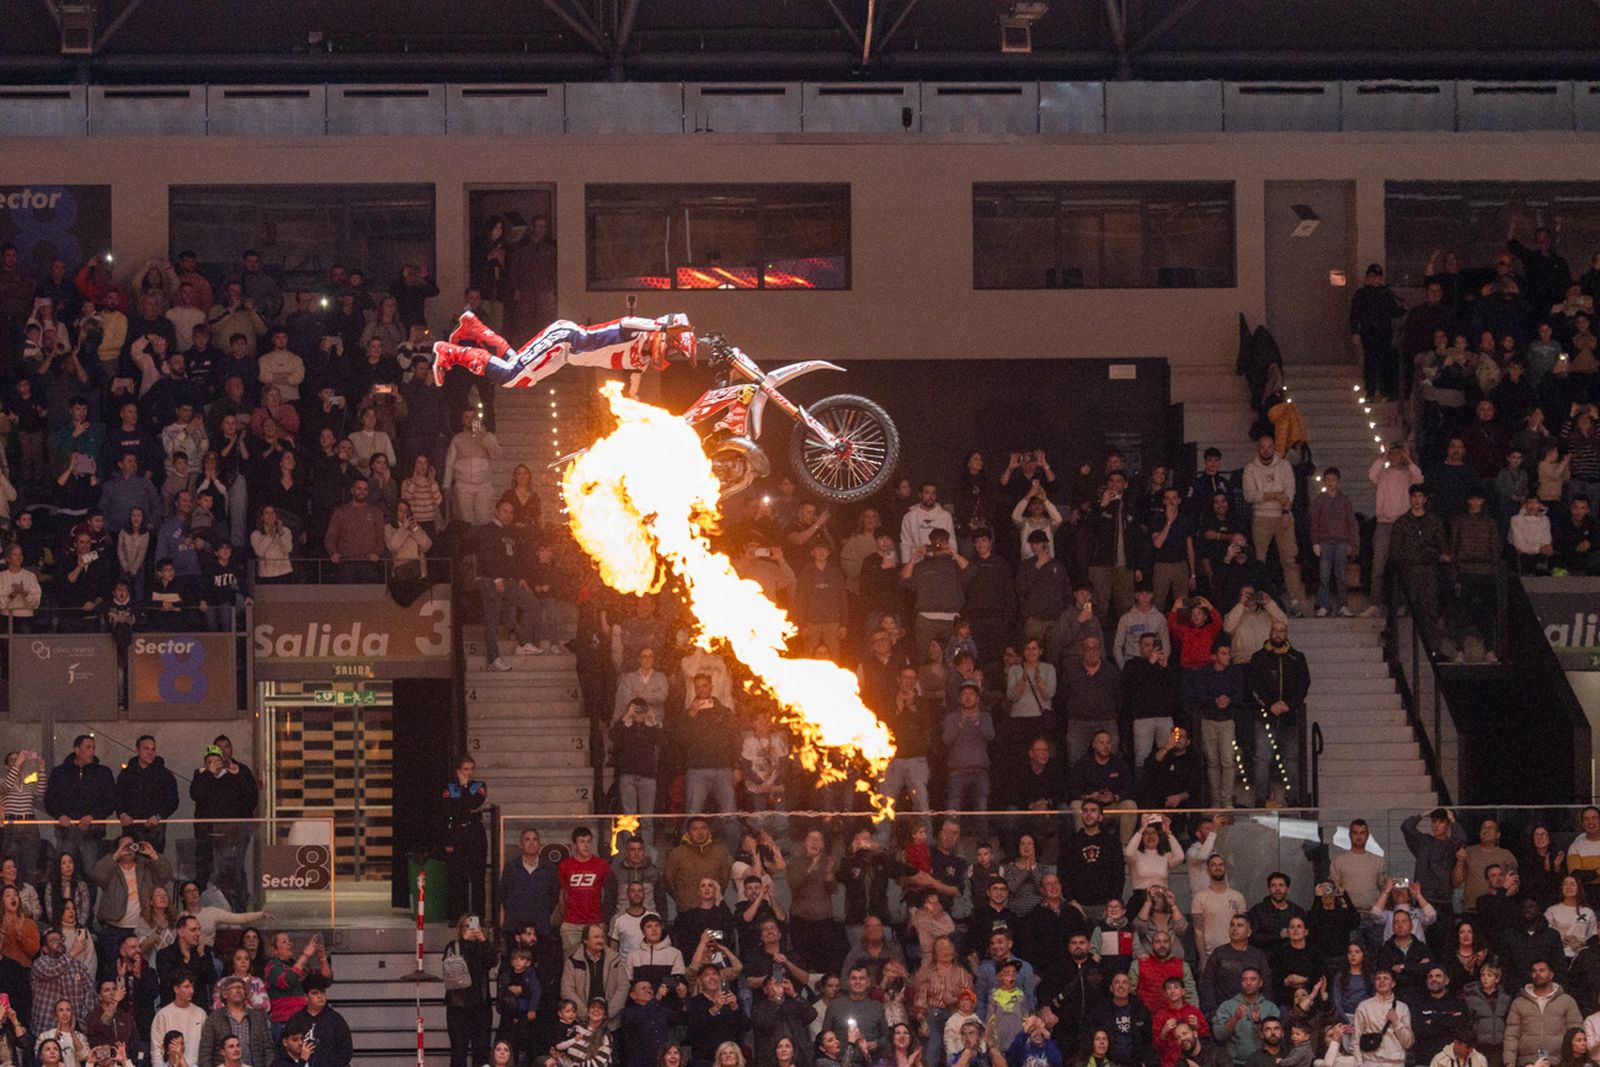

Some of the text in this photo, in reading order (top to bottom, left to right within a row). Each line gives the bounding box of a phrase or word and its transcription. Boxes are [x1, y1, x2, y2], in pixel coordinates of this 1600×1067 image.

[254, 600, 451, 657] Salida 3
[134, 638, 195, 654] Sector
[158, 634, 209, 704] 8
[335, 665, 371, 675] SALIDA
[295, 845, 331, 890] 8
[262, 874, 312, 888] Sector
[569, 873, 597, 887] 93
